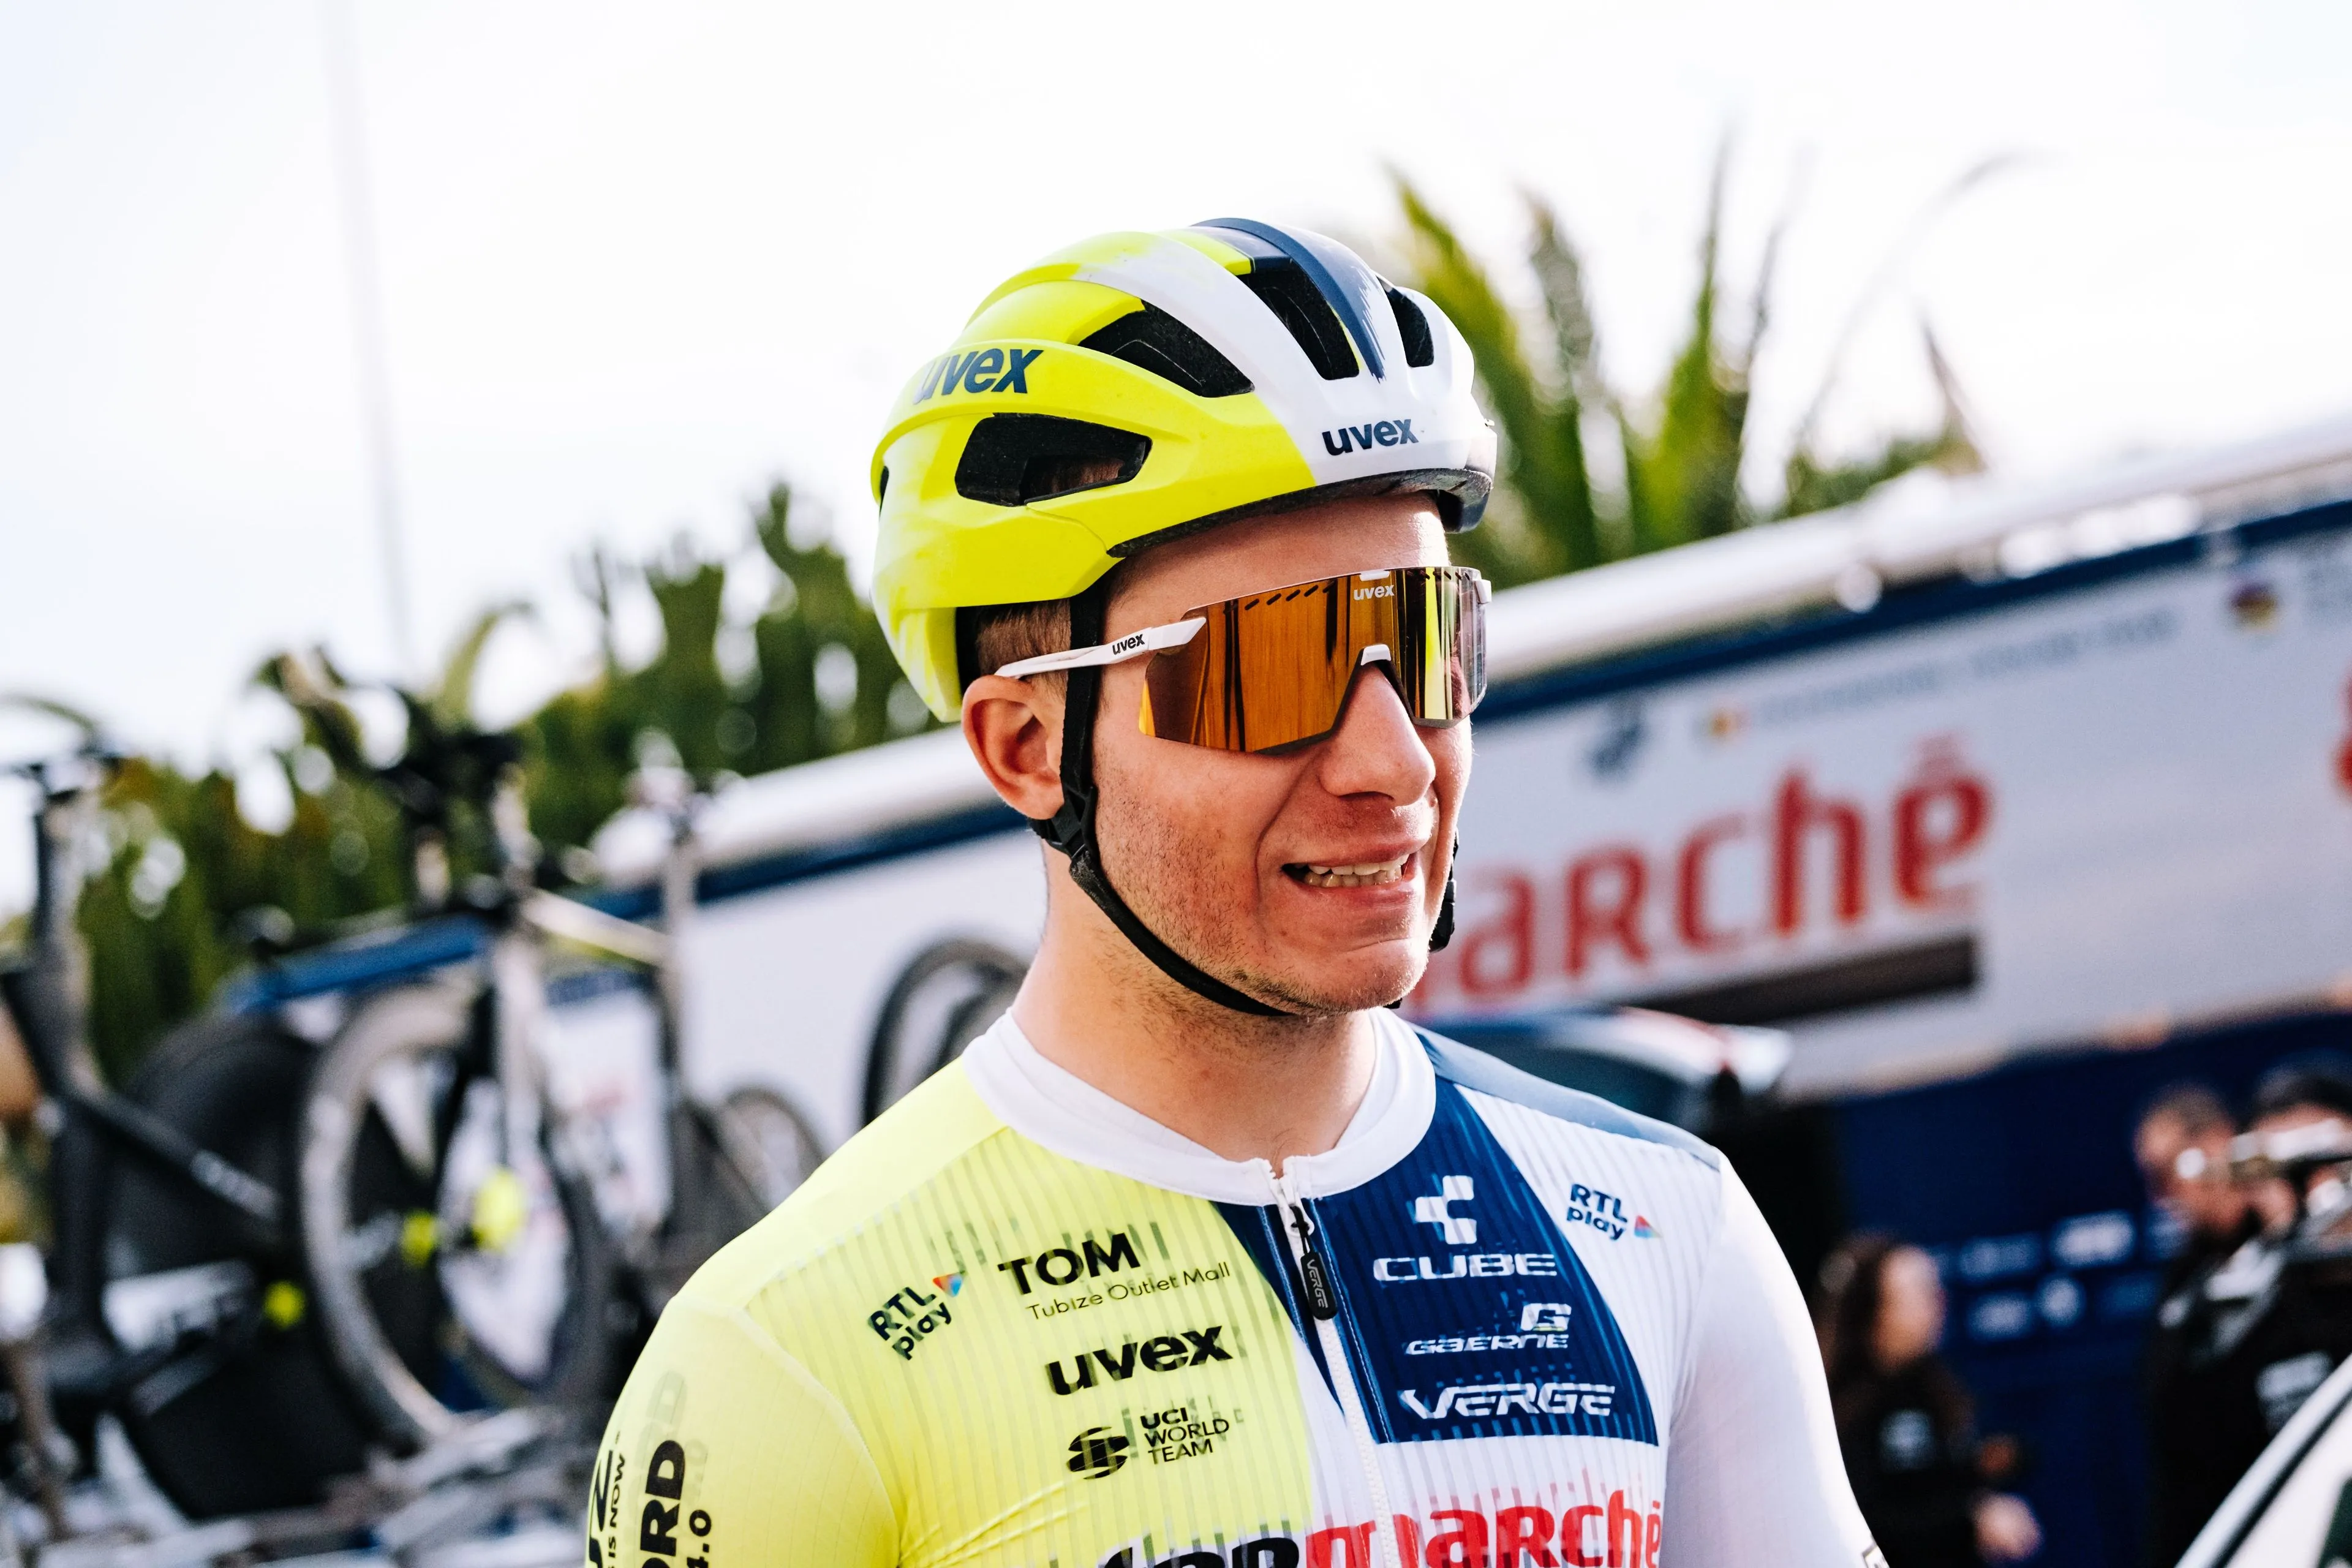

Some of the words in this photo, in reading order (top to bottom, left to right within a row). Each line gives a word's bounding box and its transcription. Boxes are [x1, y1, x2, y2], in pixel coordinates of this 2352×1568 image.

[913, 348, 1044, 405] uvex
[1322, 419, 1419, 456] uvex
[1353, 584, 1395, 601] uvex
[1112, 633, 1145, 655] uvex
[1570, 1183, 1627, 1223] RTL
[1566, 1207, 1627, 1240] play
[997, 1232, 1141, 1295] TOM
[1373, 1253, 1558, 1281] CUBE
[1025, 1293, 1103, 1320] Tubize
[1108, 1274, 1180, 1300] Outlet
[1183, 1261, 1231, 1286] Mall
[1306, 1259, 1329, 1309] VERGE
[867, 1286, 937, 1341] RTL
[891, 1302, 952, 1361] play
[1044, 1325, 1233, 1396] uvex
[1140, 1408, 1188, 1429] UCI
[1397, 1382, 1616, 1420] VERGE
[1144, 1418, 1229, 1447] WORLD
[1148, 1438, 1213, 1464] TEAM
[609, 1452, 625, 1529] NOW
[640, 1439, 686, 1568] RD
